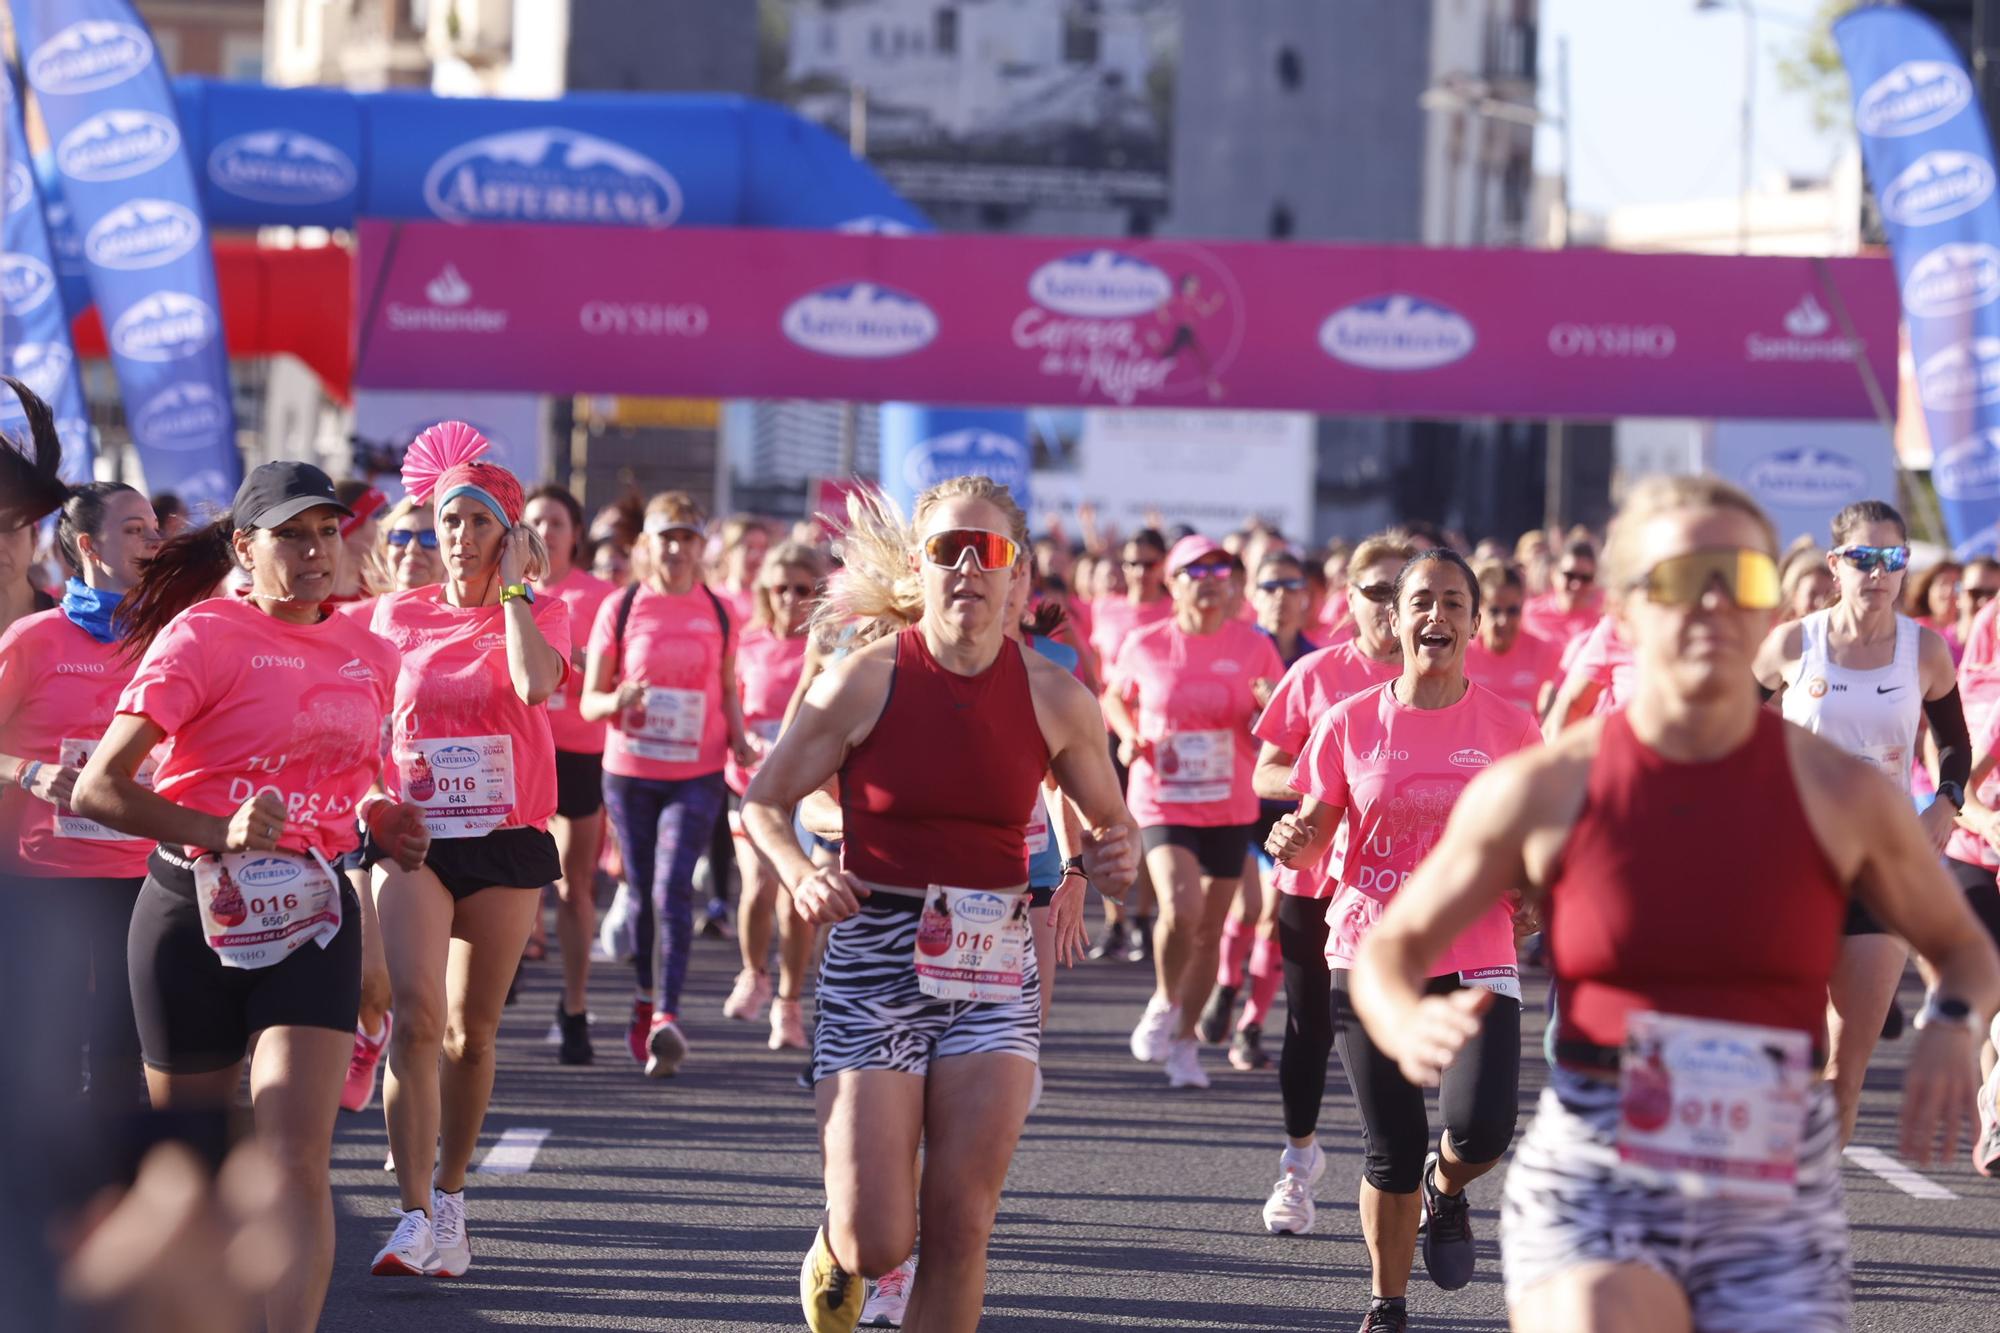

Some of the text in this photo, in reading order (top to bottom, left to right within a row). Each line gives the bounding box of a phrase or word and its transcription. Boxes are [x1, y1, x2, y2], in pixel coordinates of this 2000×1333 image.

[581, 302, 707, 336] OYSHO
[1548, 323, 1675, 357] OYSHO
[57, 663, 104, 673] OYSHO
[252, 655, 305, 670] OYSHO
[435, 755, 477, 764] ASTURIANA
[438, 777, 475, 792] 016
[449, 794, 467, 804] 643
[65, 822, 100, 832] OYSHO
[244, 867, 298, 881] ASTURIANA
[251, 893, 298, 914] 016
[262, 912, 290, 927] 6500
[956, 931, 994, 951] 016
[1473, 968, 1503, 977] CARRERA
